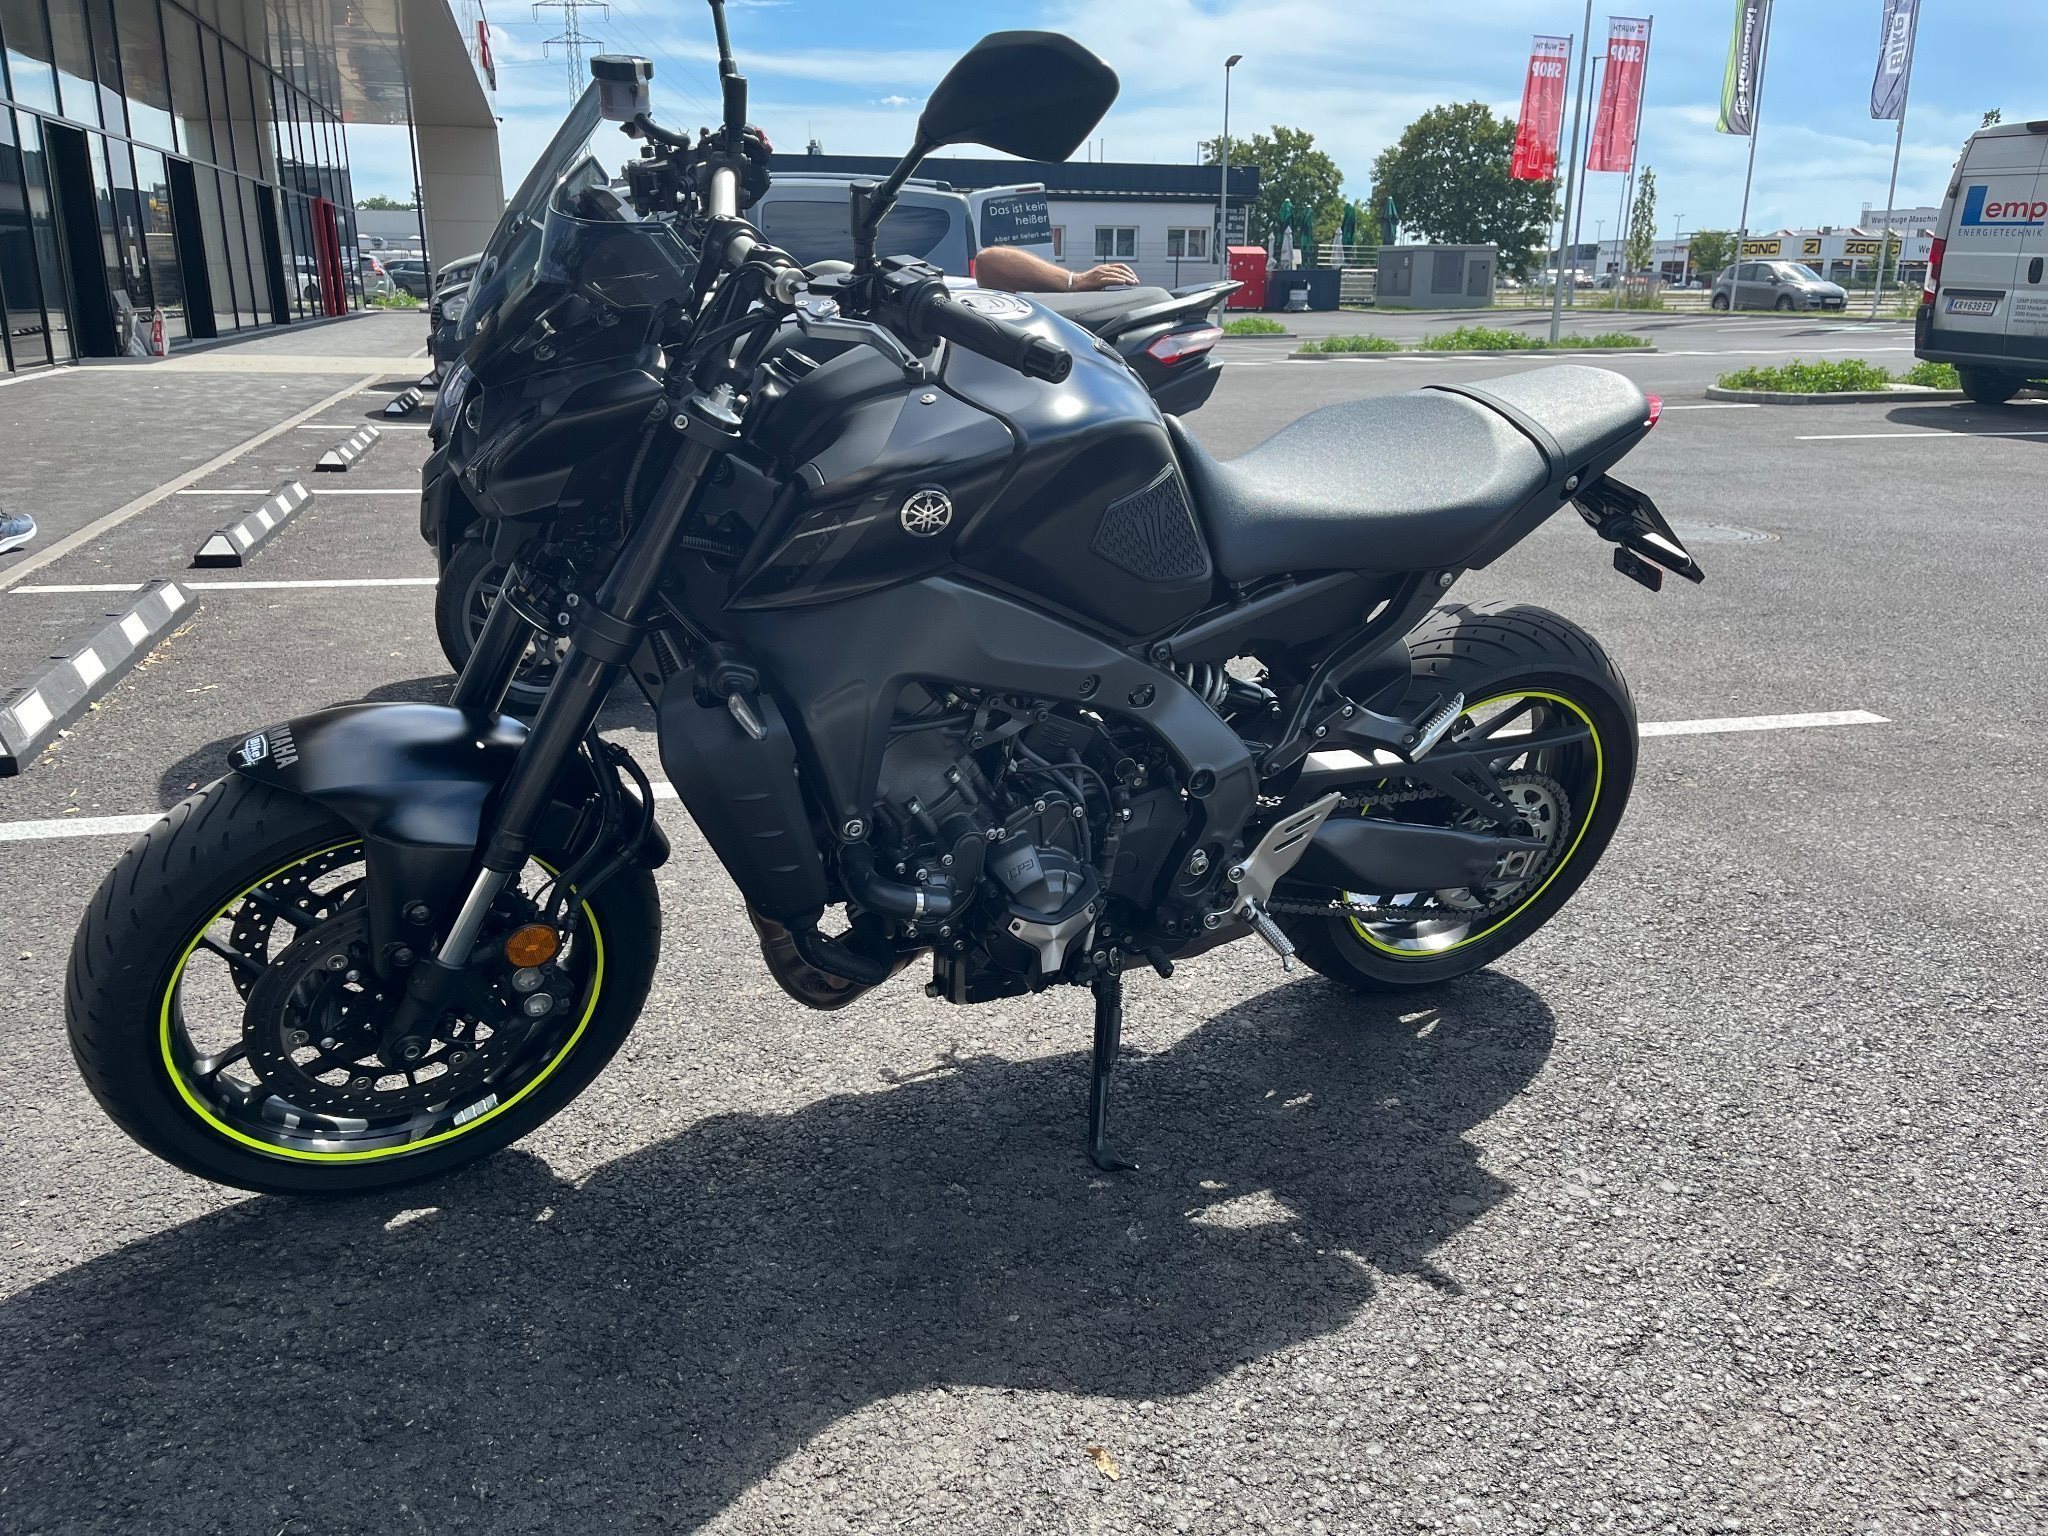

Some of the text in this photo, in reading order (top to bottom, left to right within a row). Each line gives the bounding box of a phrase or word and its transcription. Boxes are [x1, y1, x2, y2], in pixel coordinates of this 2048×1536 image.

[989, 201, 1047, 216] Das ist kein
[1015, 214, 1048, 226] heißer
[1871, 216, 1908, 225] Werkeuge
[1958, 228, 2044, 237] ENERGIETECHNIK
[1741, 243, 1778, 255] GONC
[1803, 243, 1817, 254] Z
[1953, 300, 1963, 309] KR
